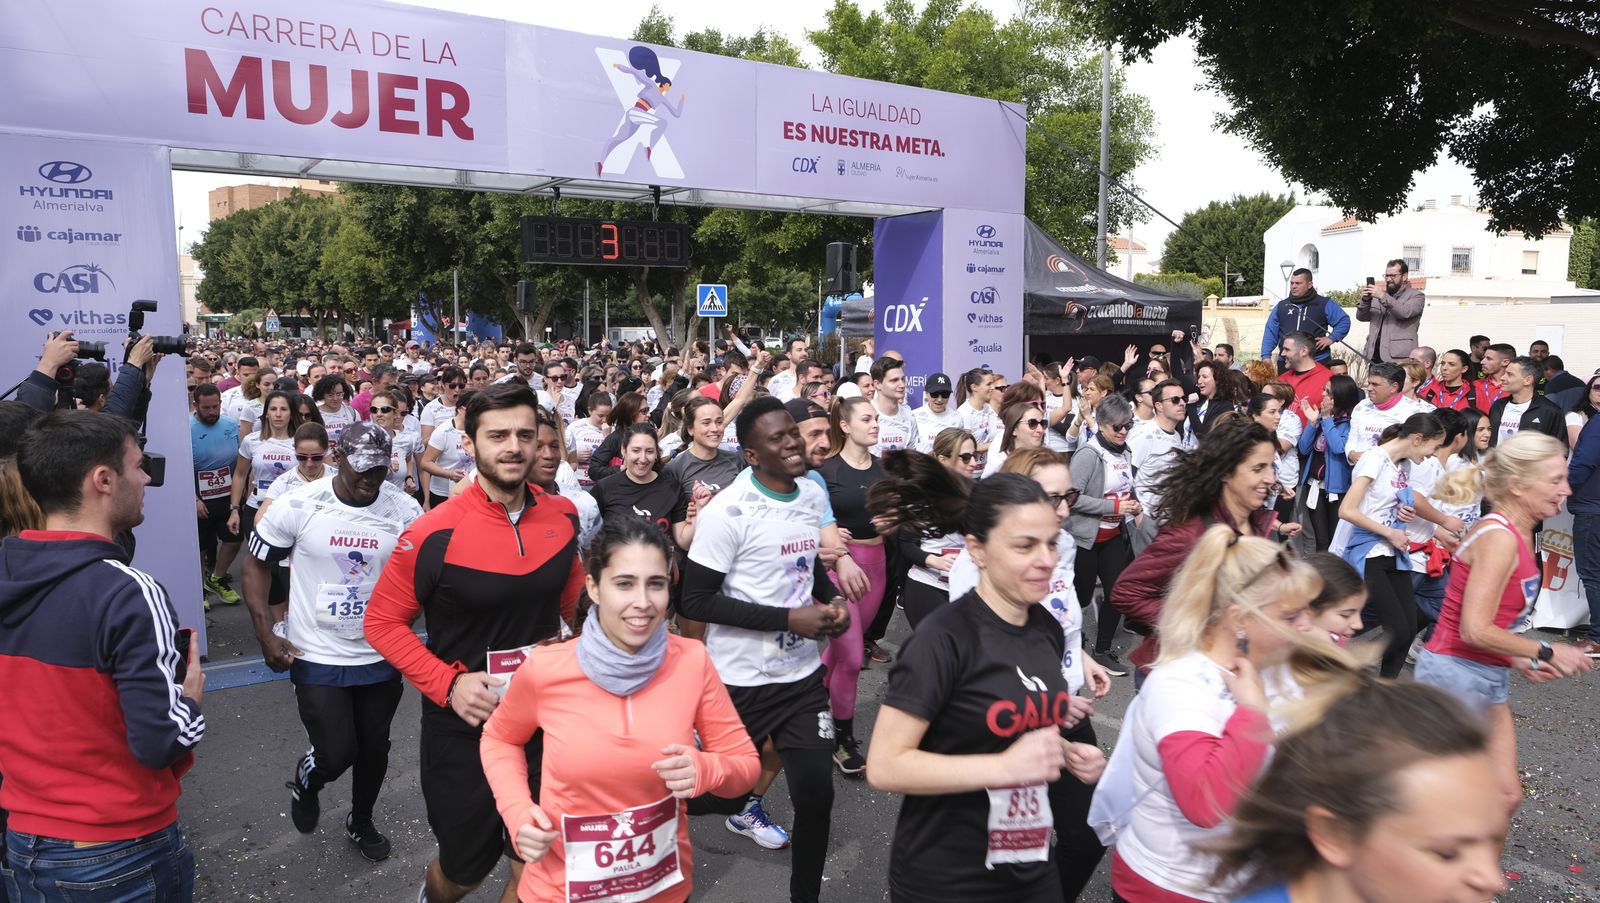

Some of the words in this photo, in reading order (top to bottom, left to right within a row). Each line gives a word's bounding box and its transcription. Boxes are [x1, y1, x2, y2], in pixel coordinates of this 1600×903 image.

[201, 7, 361, 54] CARRERA
[372, 32, 411, 60] DE
[422, 38, 457, 66] LA
[184, 47, 475, 141] MUJER
[812, 93, 833, 114] LA
[839, 97, 921, 125] IGUALDAD
[783, 121, 807, 141] ES
[811, 124, 893, 152] NUESTRA
[896, 135, 946, 157] META.
[792, 156, 821, 174] CDX
[20, 186, 113, 200] HYUNDAI
[33, 200, 104, 212] Almerialva
[47, 229, 122, 244] cajamar
[601, 224, 619, 260] 3
[968, 240, 1003, 248] HYUNDAI
[977, 264, 1005, 274] cajamar
[33, 272, 99, 293] CASI
[971, 289, 995, 304] CASI
[60, 310, 126, 325] vithas
[884, 297, 928, 332] CDX
[978, 313, 1003, 323] vithas
[973, 342, 1002, 354] aqualia
[905, 374, 927, 387] MERÍ
[262, 453, 292, 462] MUJER
[207, 477, 226, 487] 643
[329, 535, 379, 549] MUJER
[781, 538, 816, 556] MUJER
[580, 823, 609, 832] MUJER
[594, 833, 656, 868] 644
[613, 861, 641, 873] PAULA
